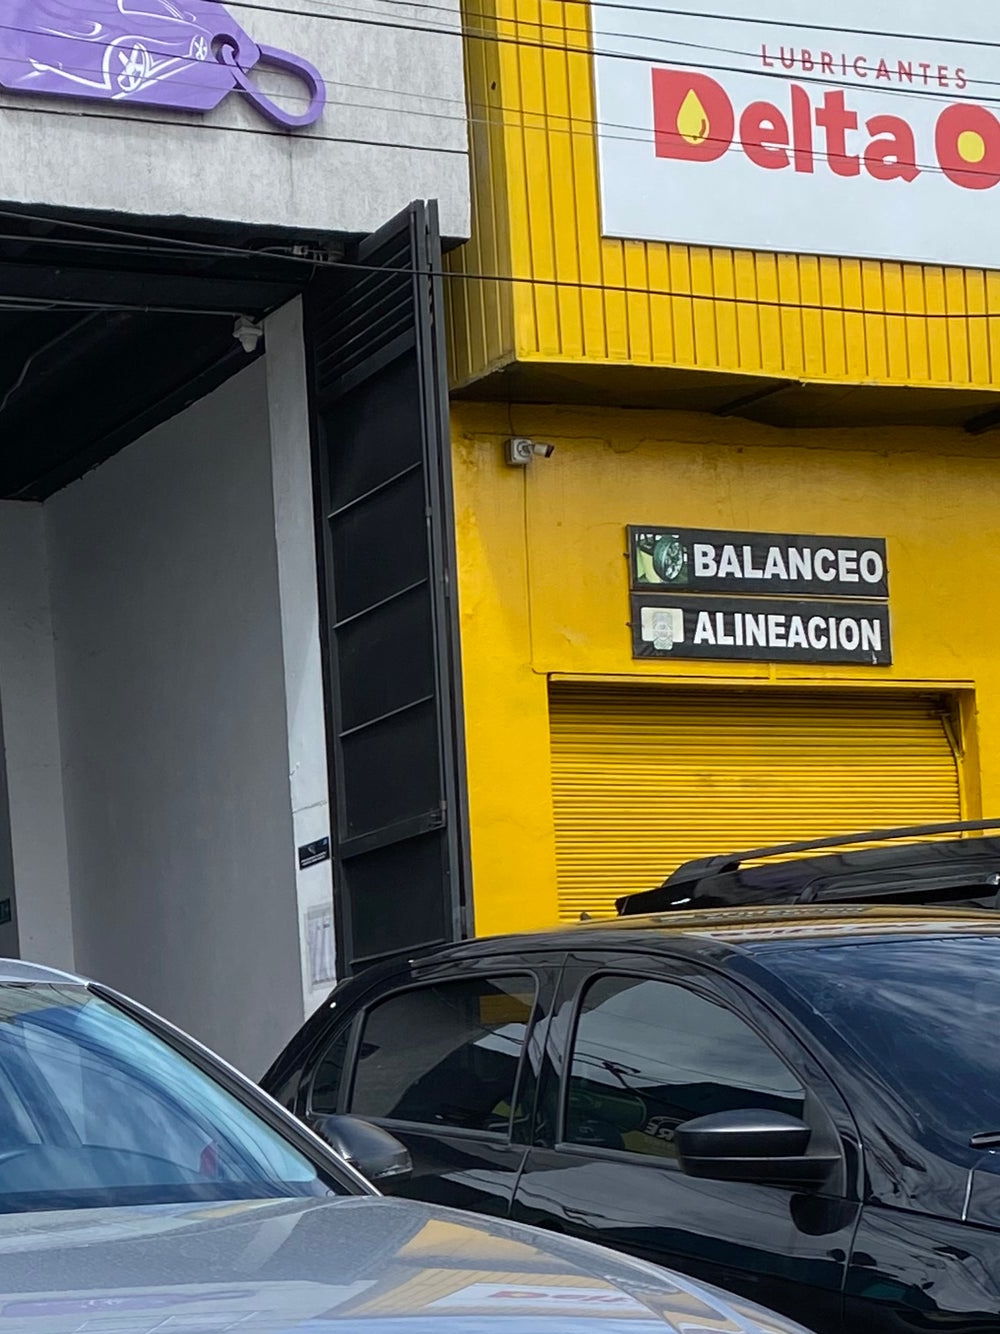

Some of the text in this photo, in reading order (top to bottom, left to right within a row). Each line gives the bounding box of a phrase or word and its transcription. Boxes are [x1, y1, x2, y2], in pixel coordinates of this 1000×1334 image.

[761, 44, 967, 89] LUBRICANTES
[651, 67, 921, 183] Delta
[694, 544, 884, 583] BALANCEO
[694, 611, 882, 651] ALINEACION
